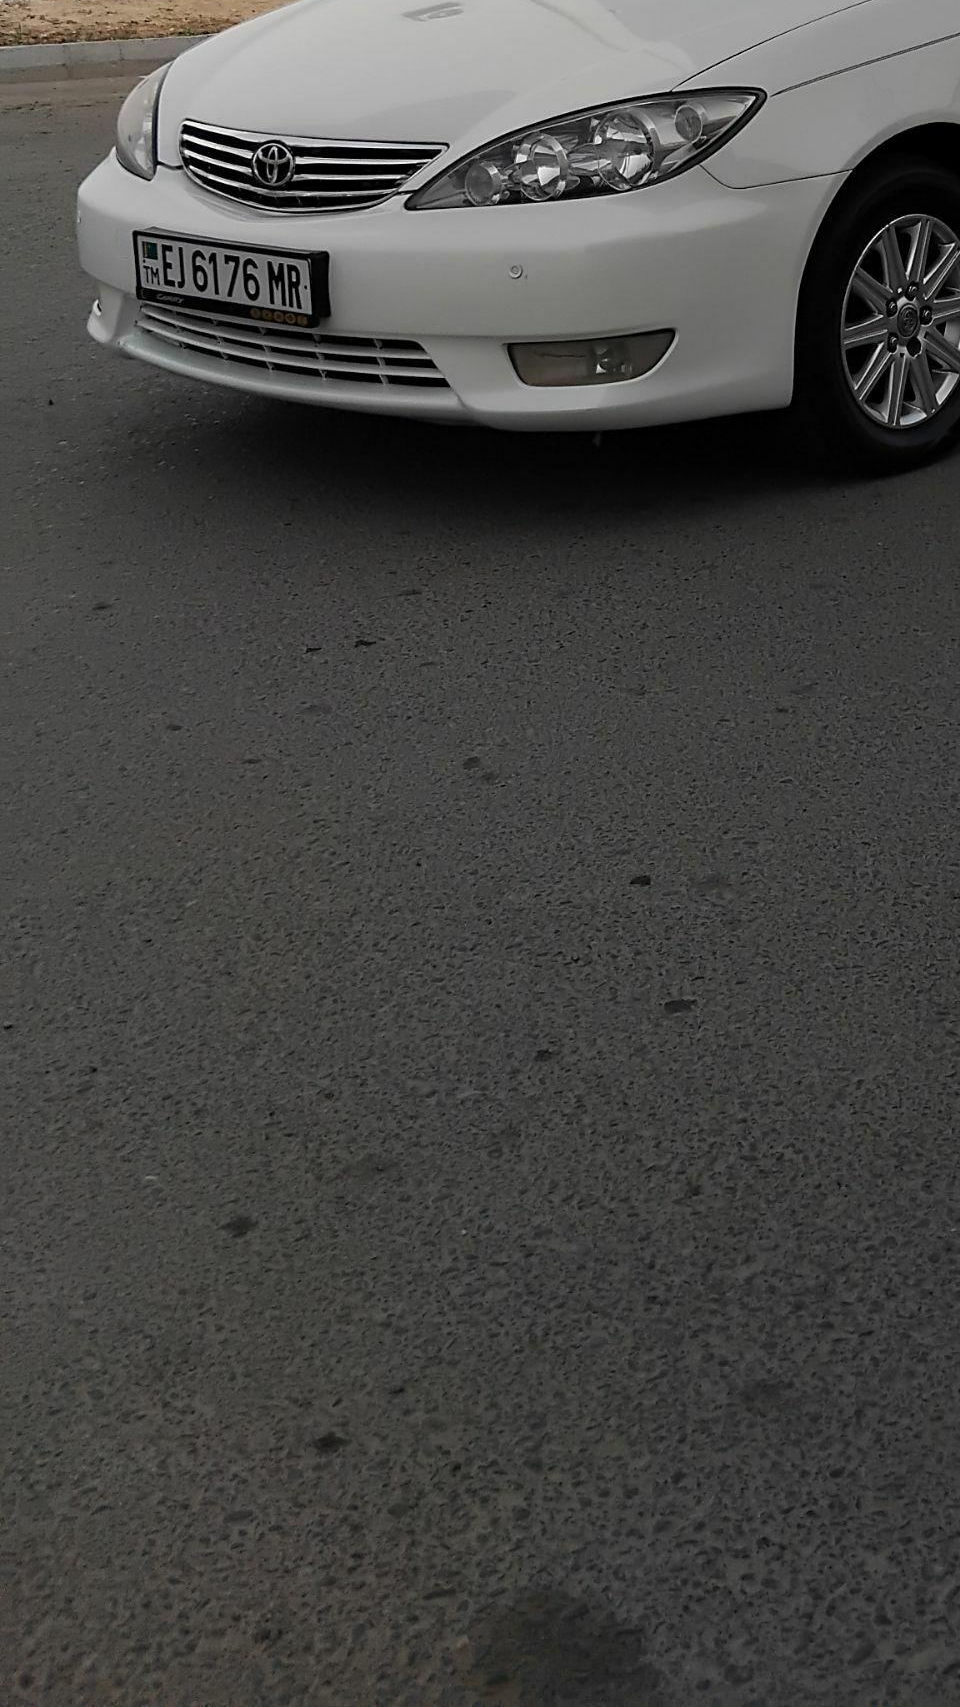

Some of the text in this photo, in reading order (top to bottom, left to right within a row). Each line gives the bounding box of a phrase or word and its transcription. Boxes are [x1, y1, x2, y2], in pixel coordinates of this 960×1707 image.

[143, 265, 161, 285] TM
[161, 244, 303, 310] EJ 6176 MR
